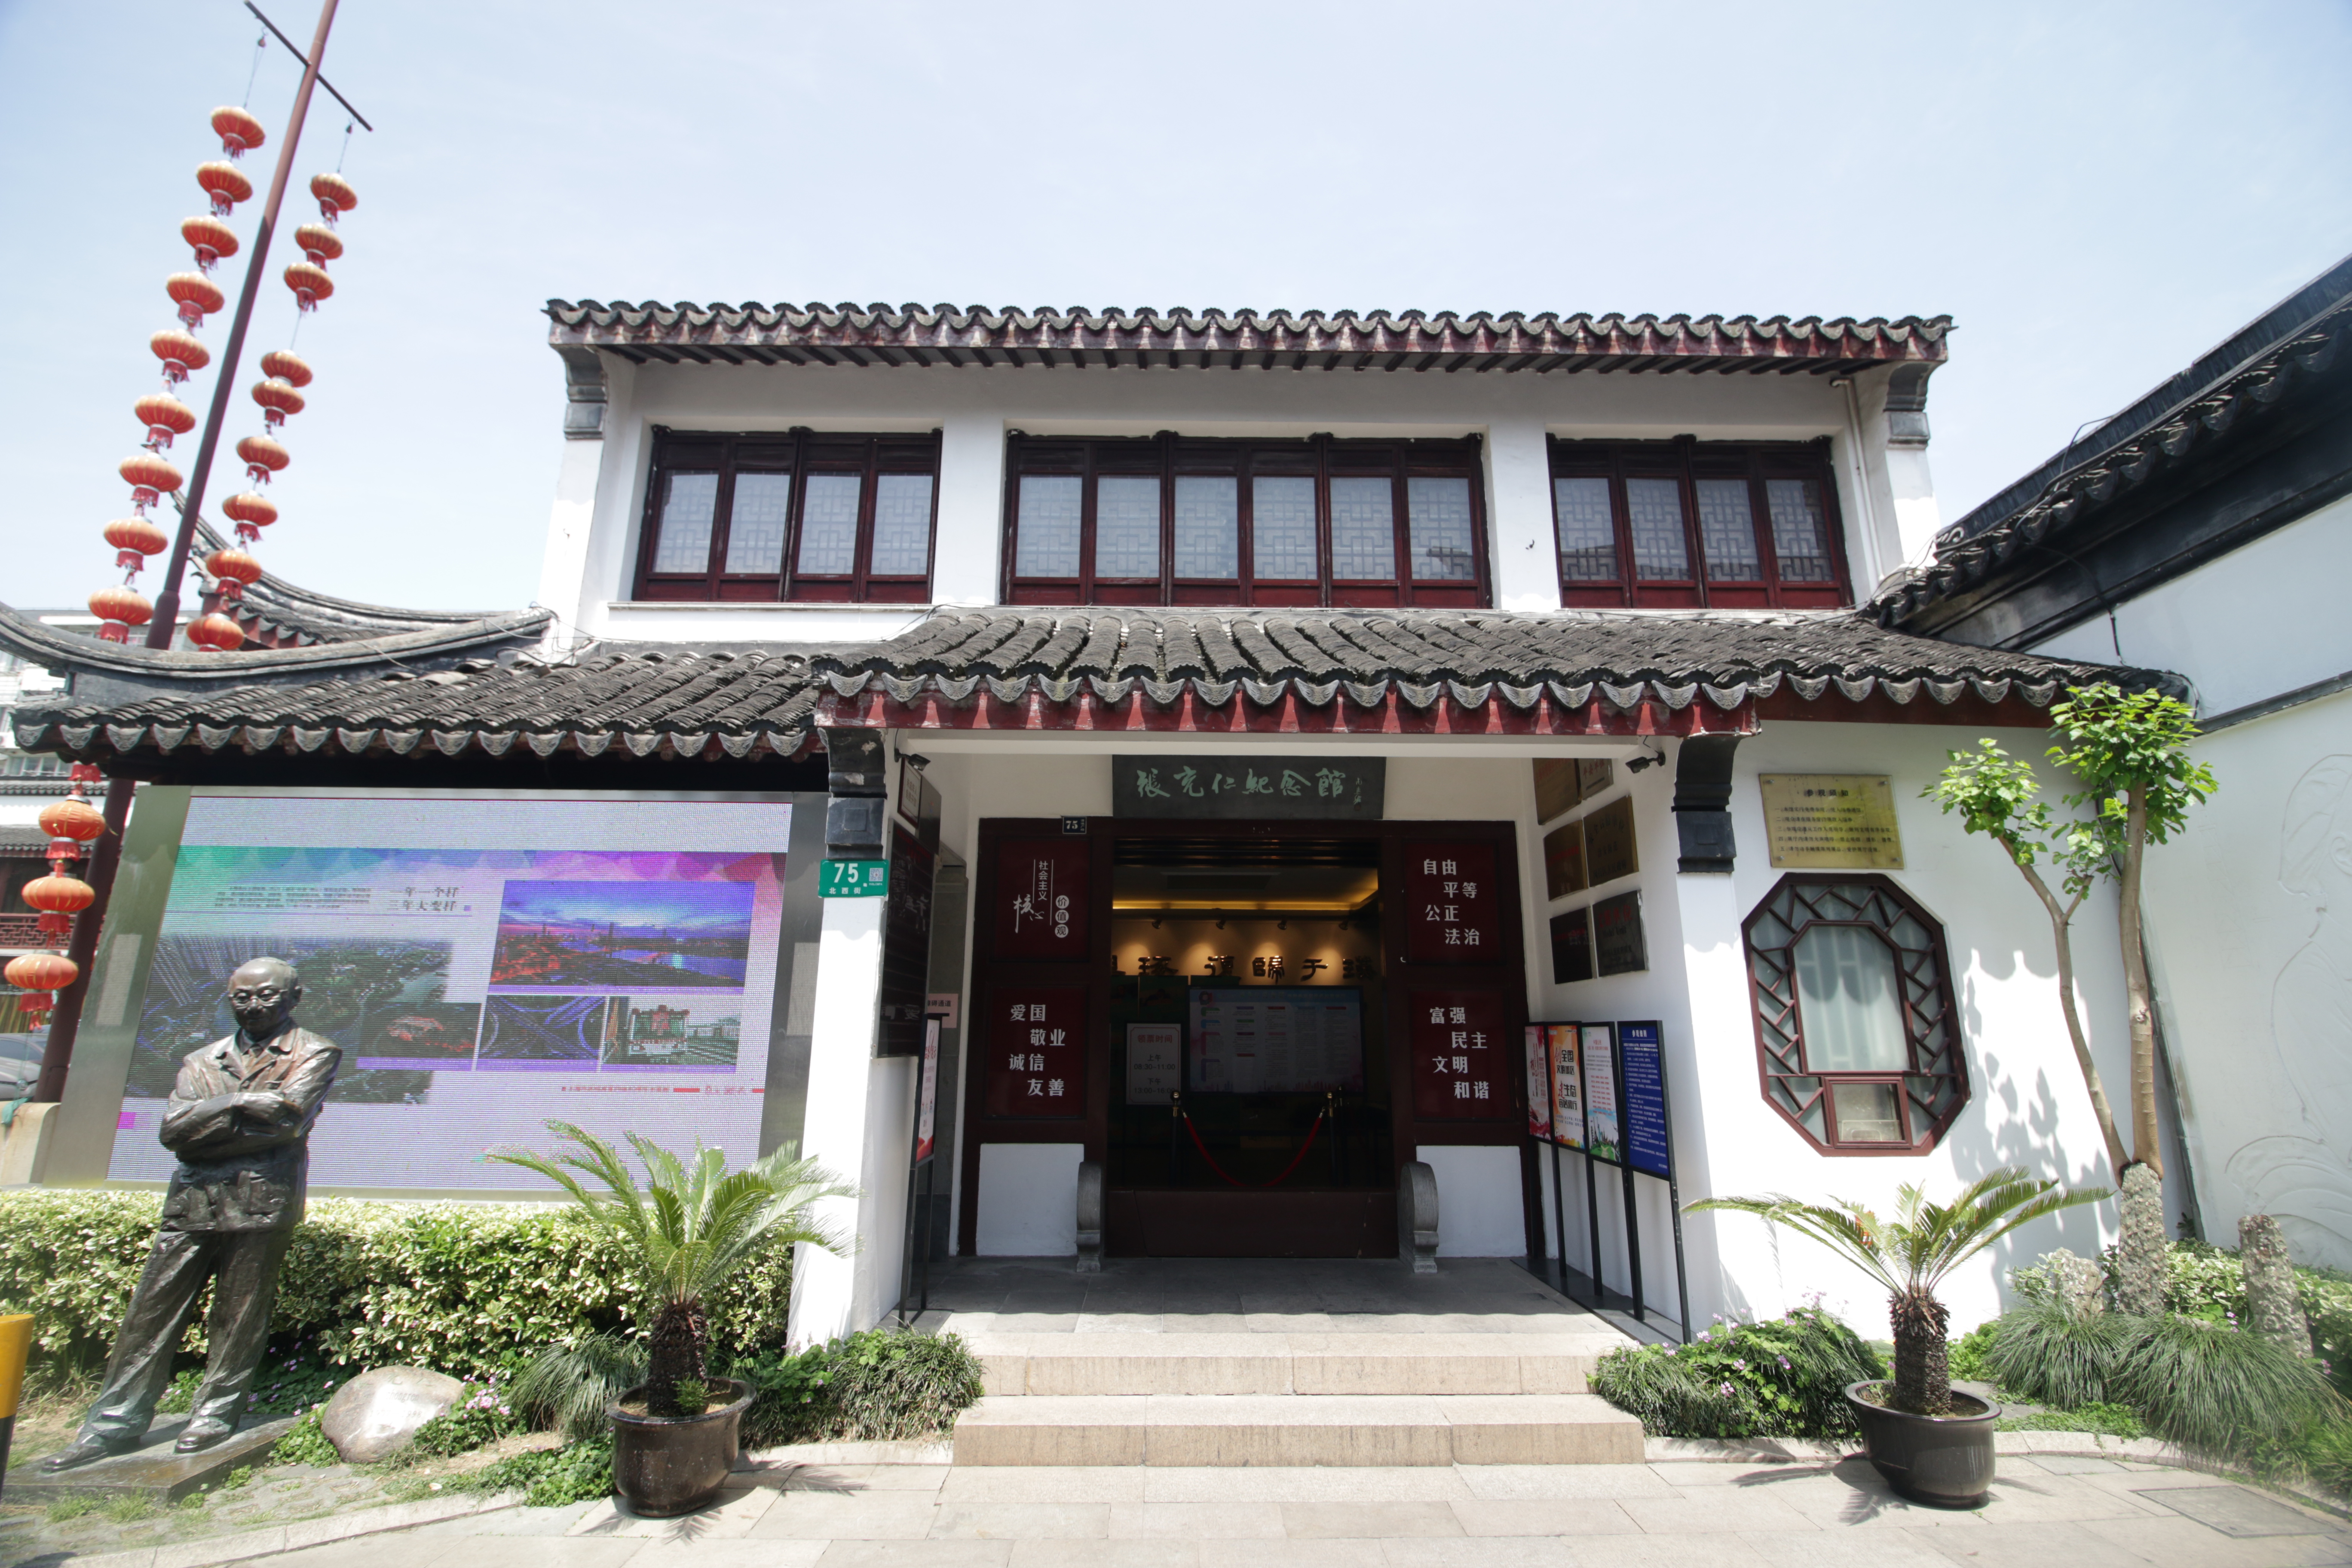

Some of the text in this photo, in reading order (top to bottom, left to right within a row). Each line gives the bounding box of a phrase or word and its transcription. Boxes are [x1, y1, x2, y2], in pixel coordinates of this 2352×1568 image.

[1066, 820, 1078, 830] 75
[833, 863, 859, 883] 75
[1424, 859, 1457, 876] 自由
[1038, 861, 1048, 900] 社会主义
[1443, 882, 1477, 898] 平等
[1013, 894, 1044, 934] 核心
[1056, 896, 1068, 936] 价值观
[1425, 904, 1460, 922] 公正
[1445, 928, 1480, 945] 法治
[1010, 1004, 1046, 1021] 爱国
[1429, 1007, 1466, 1024] 富强
[1030, 1029, 1066, 1046] 敬业
[1137, 1034, 1173, 1043] 领票时间
[1452, 1031, 1487, 1048] 民主
[1009, 1054, 1044, 1071] 诚信
[1432, 1056, 1468, 1073] 文明
[1027, 1078, 1064, 1096] 友善
[1454, 1081, 1489, 1099] 和谐
[386, 1389, 420, 1403] hongren
